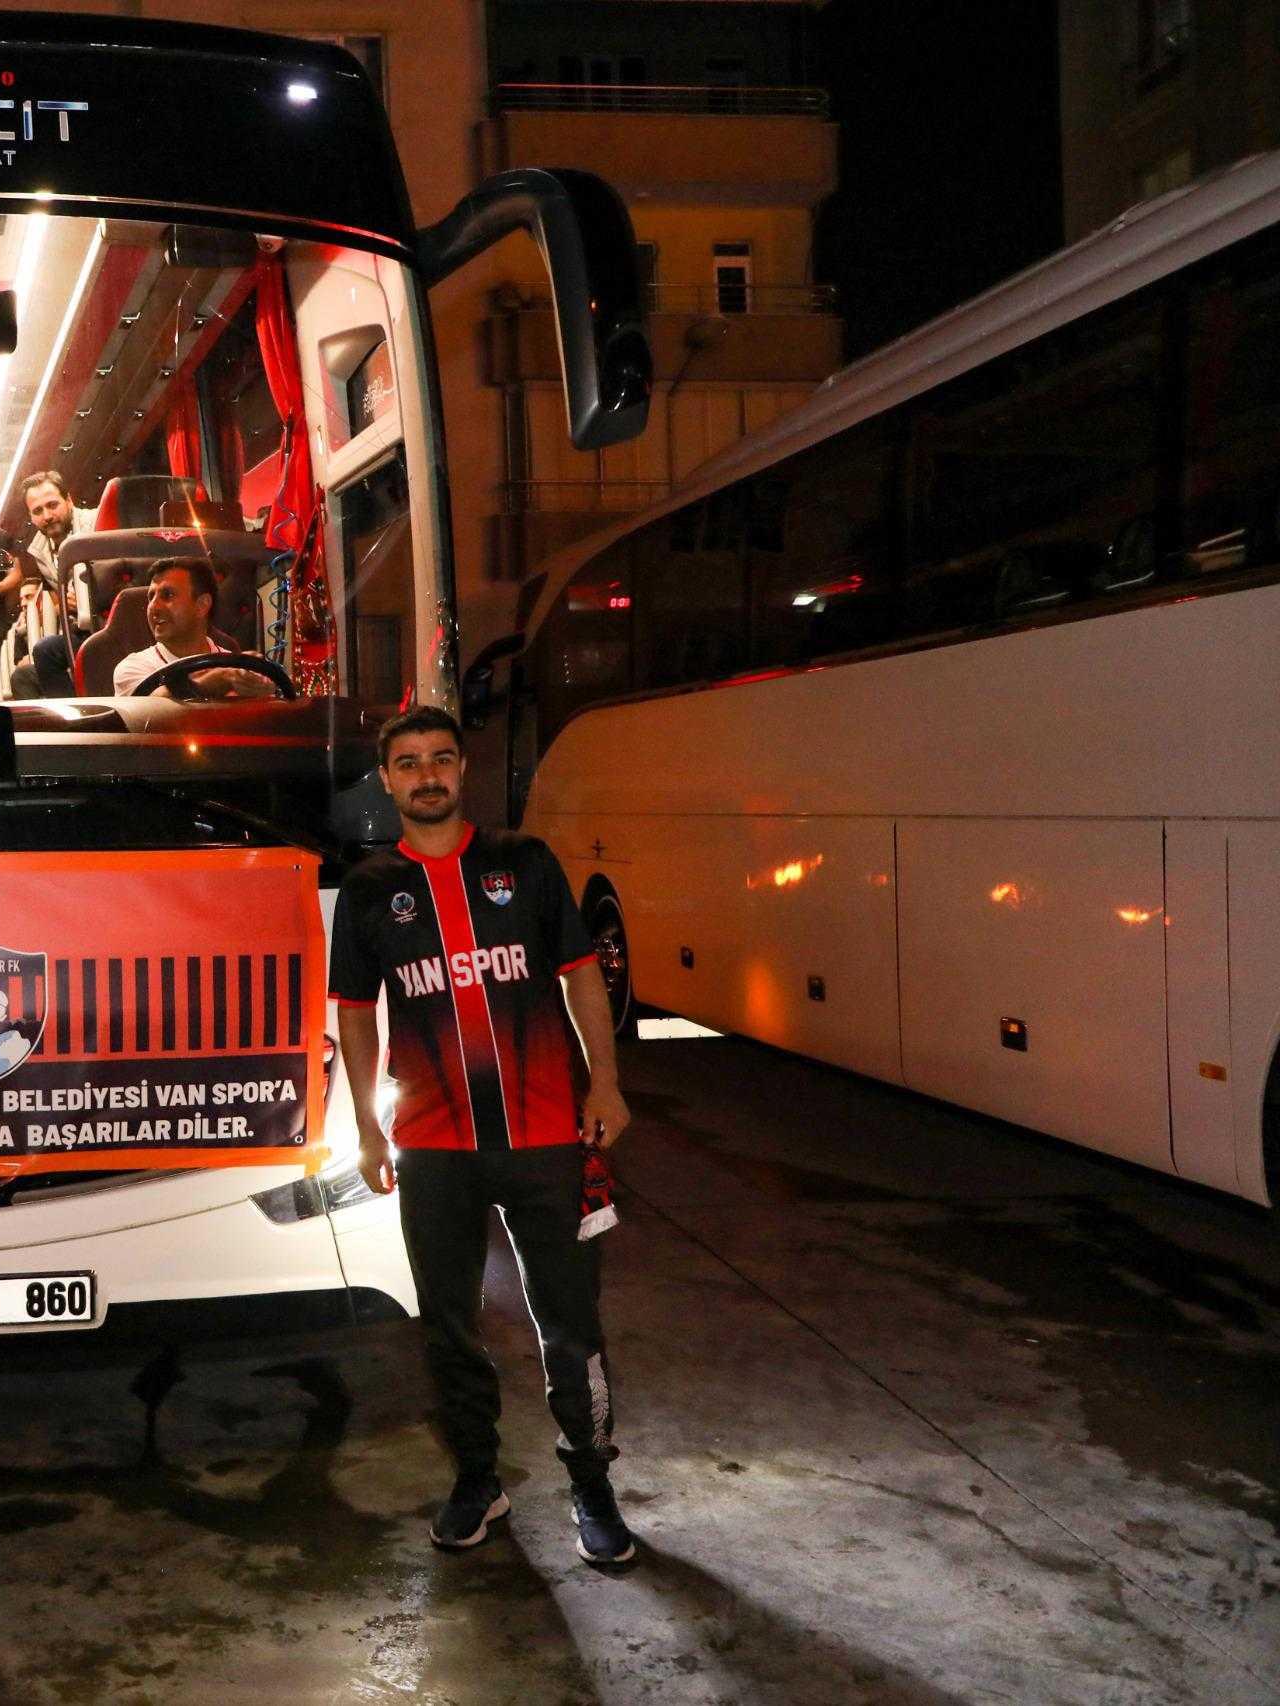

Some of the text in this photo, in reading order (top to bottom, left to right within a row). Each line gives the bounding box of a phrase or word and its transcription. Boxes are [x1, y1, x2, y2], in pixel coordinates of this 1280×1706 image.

[8, 959, 20, 973] FK
[396, 944, 530, 998] VAN SPOR
[2, 1079, 148, 1112] BELEDİYESİ
[154, 1084, 206, 1106] VAN
[27, 1121, 171, 1150] BAŞARILAR
[177, 1112, 255, 1140] DİLER.
[26, 1281, 87, 1318] 860
